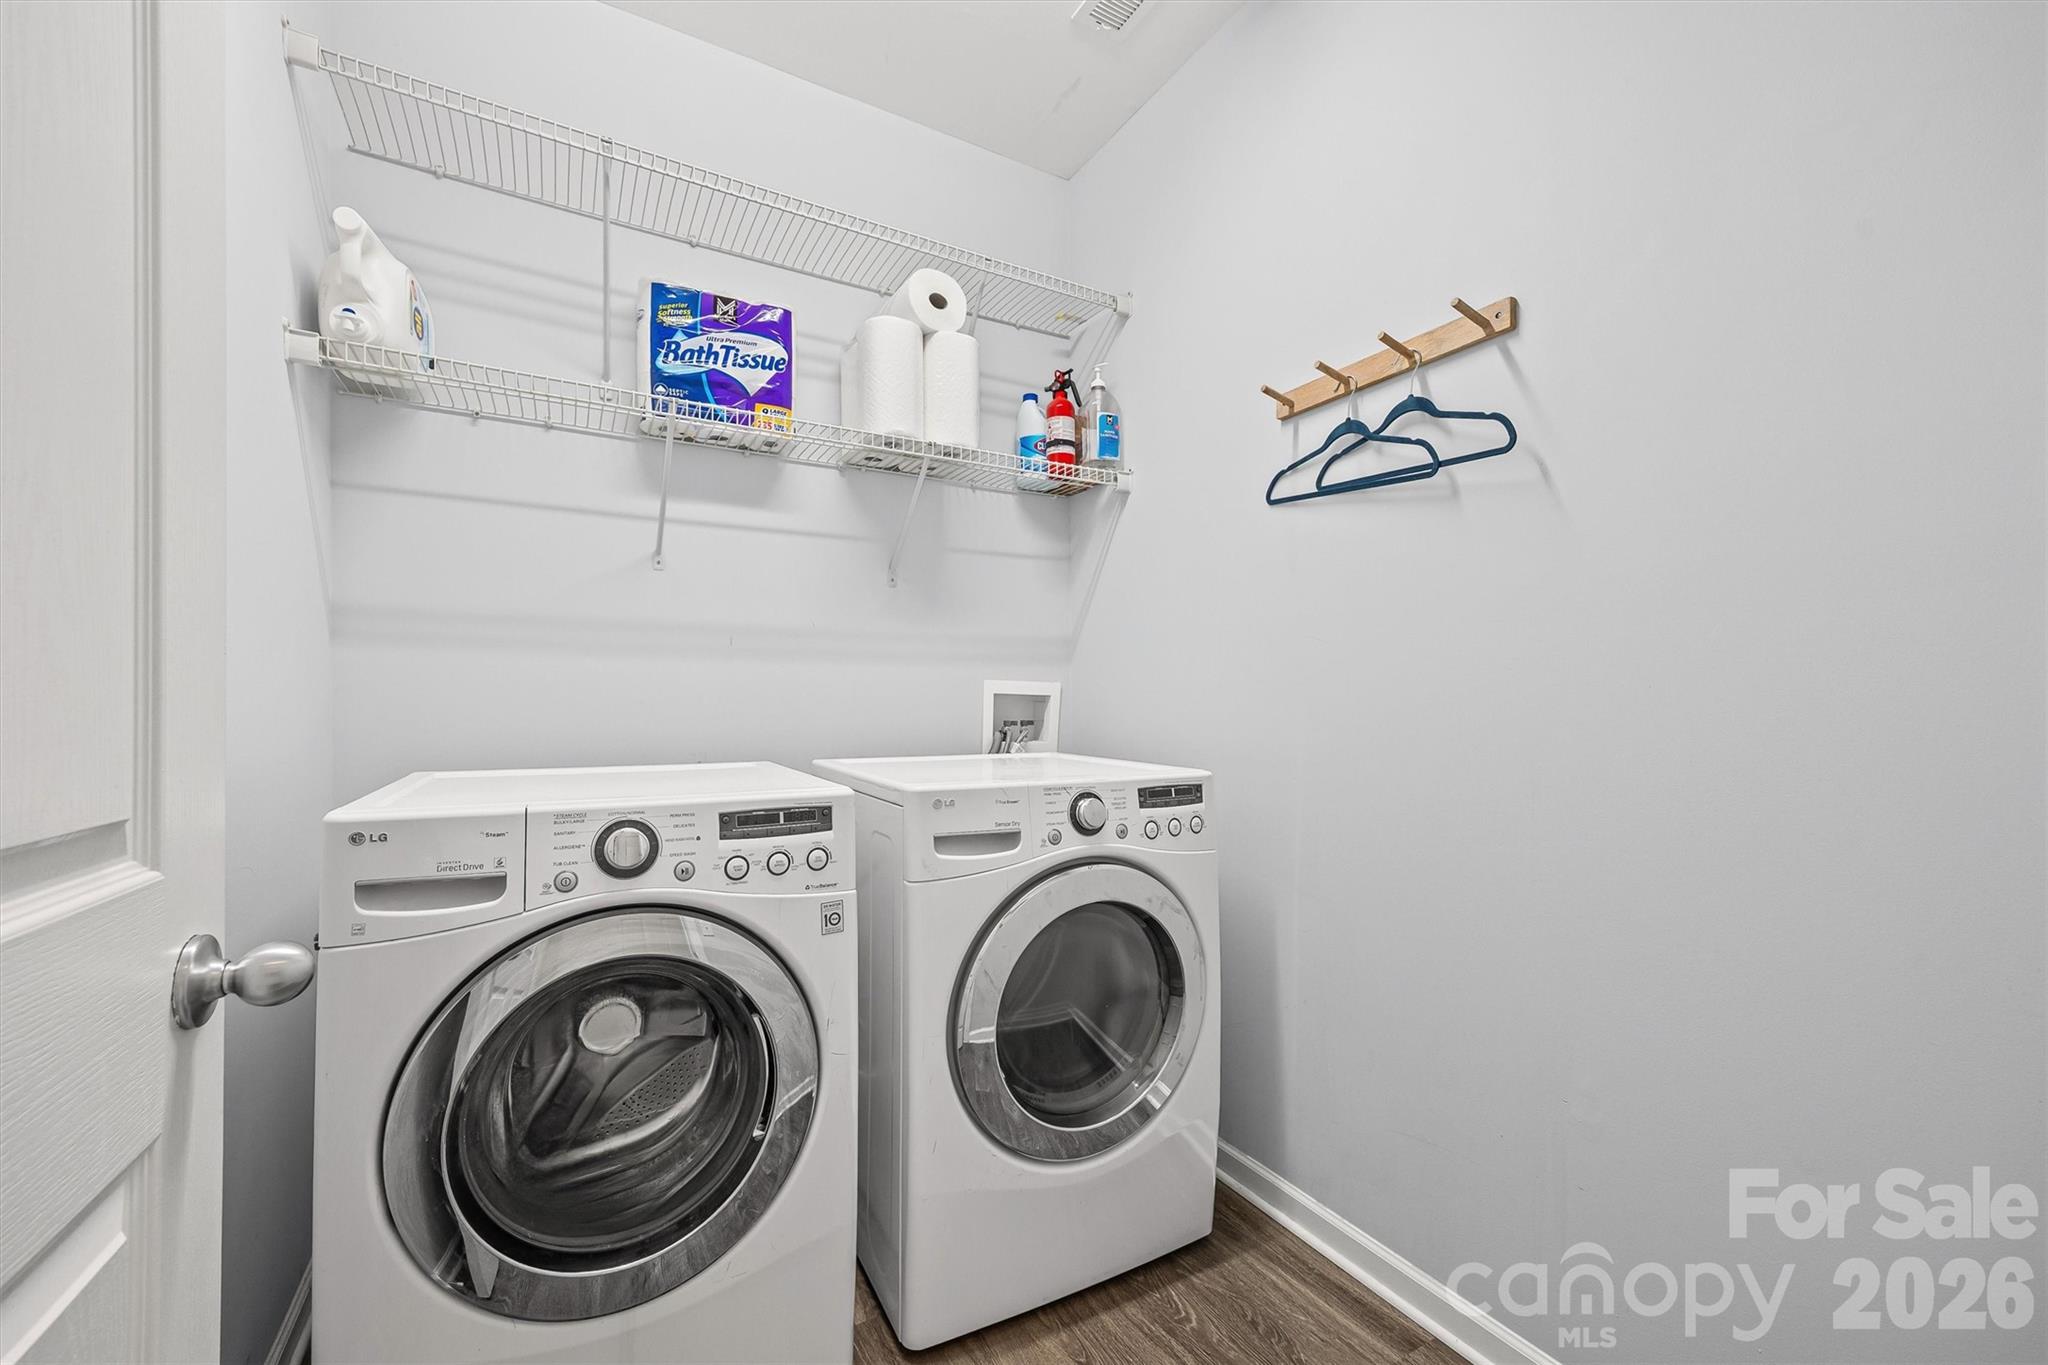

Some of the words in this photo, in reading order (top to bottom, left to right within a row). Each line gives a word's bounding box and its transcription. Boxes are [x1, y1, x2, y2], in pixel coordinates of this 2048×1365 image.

[706, 335, 724, 343] Ultra
[725, 337, 758, 347] Premium
[944, 799, 955, 807] LG
[370, 833, 388, 843] LG
[436, 863, 462, 873] Direct
[462, 863, 485, 871] Drive
